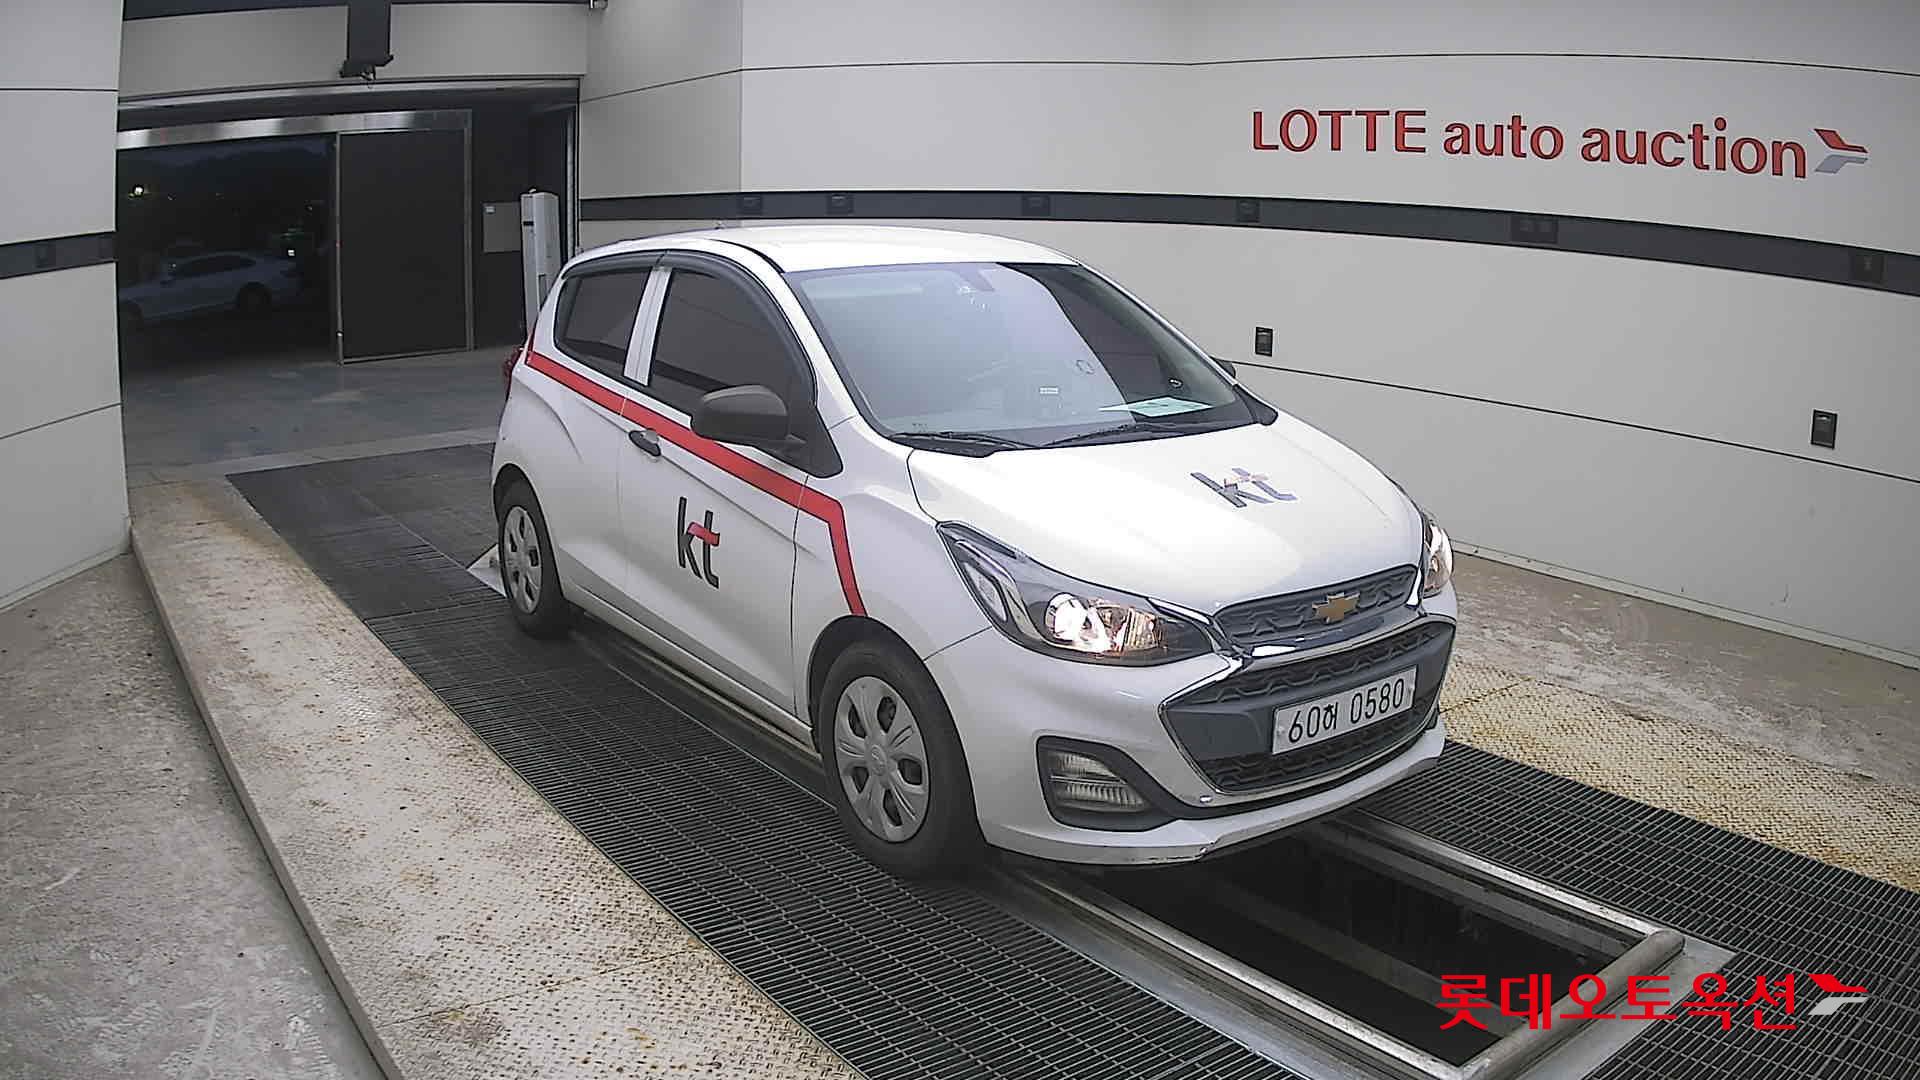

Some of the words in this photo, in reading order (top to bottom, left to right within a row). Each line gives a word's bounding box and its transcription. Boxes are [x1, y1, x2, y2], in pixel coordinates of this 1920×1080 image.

[1252, 110, 1428, 153] LOTTE
[1443, 114, 1565, 159] auto
[1580, 116, 1807, 179] auction
[1190, 467, 1297, 508] kt
[677, 496, 720, 589] kt
[1350, 678, 1405, 724] 0580
